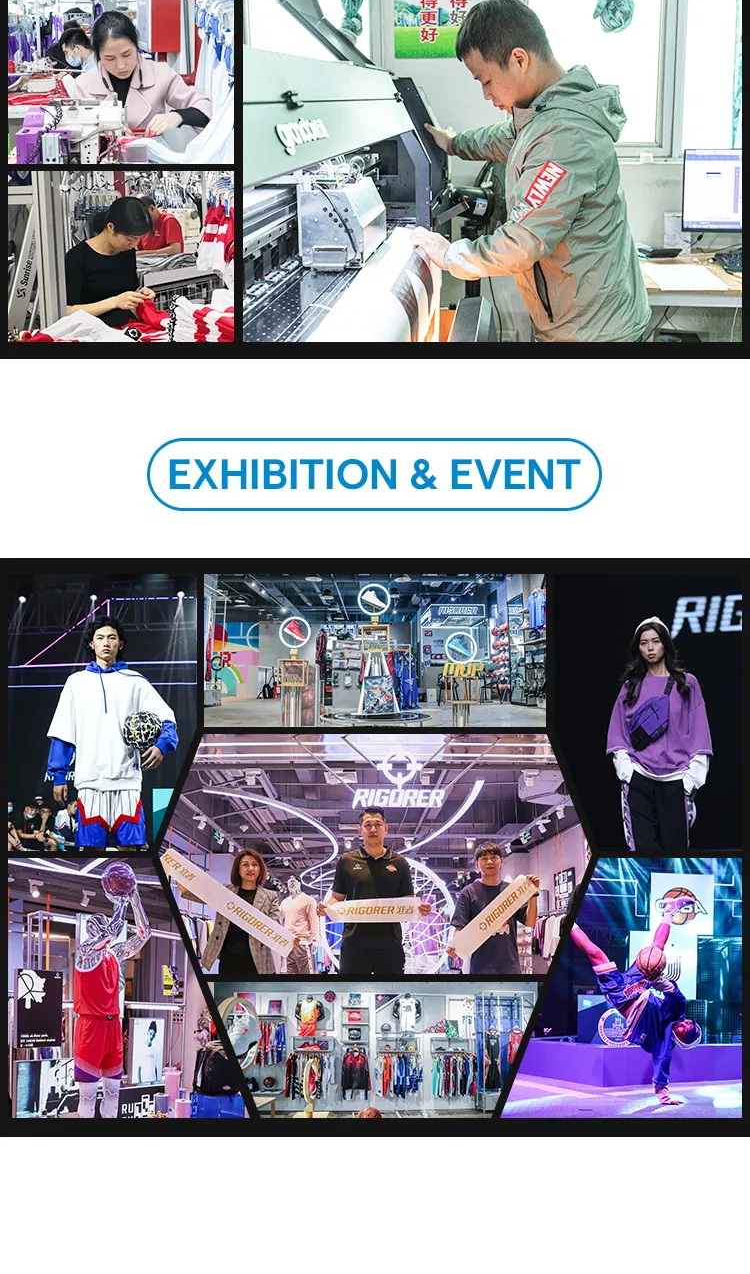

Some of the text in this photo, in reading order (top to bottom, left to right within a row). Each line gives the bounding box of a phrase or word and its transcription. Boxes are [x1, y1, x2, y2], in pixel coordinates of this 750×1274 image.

[526, 161, 565, 209] NEWLY
[20, 259, 33, 286] Sunrise
[352, 789, 445, 809] RIGORER
[232, 907, 275, 937] RIGORER
[347, 906, 394, 915] RIGORER
[485, 892, 519, 927] RIGORER
